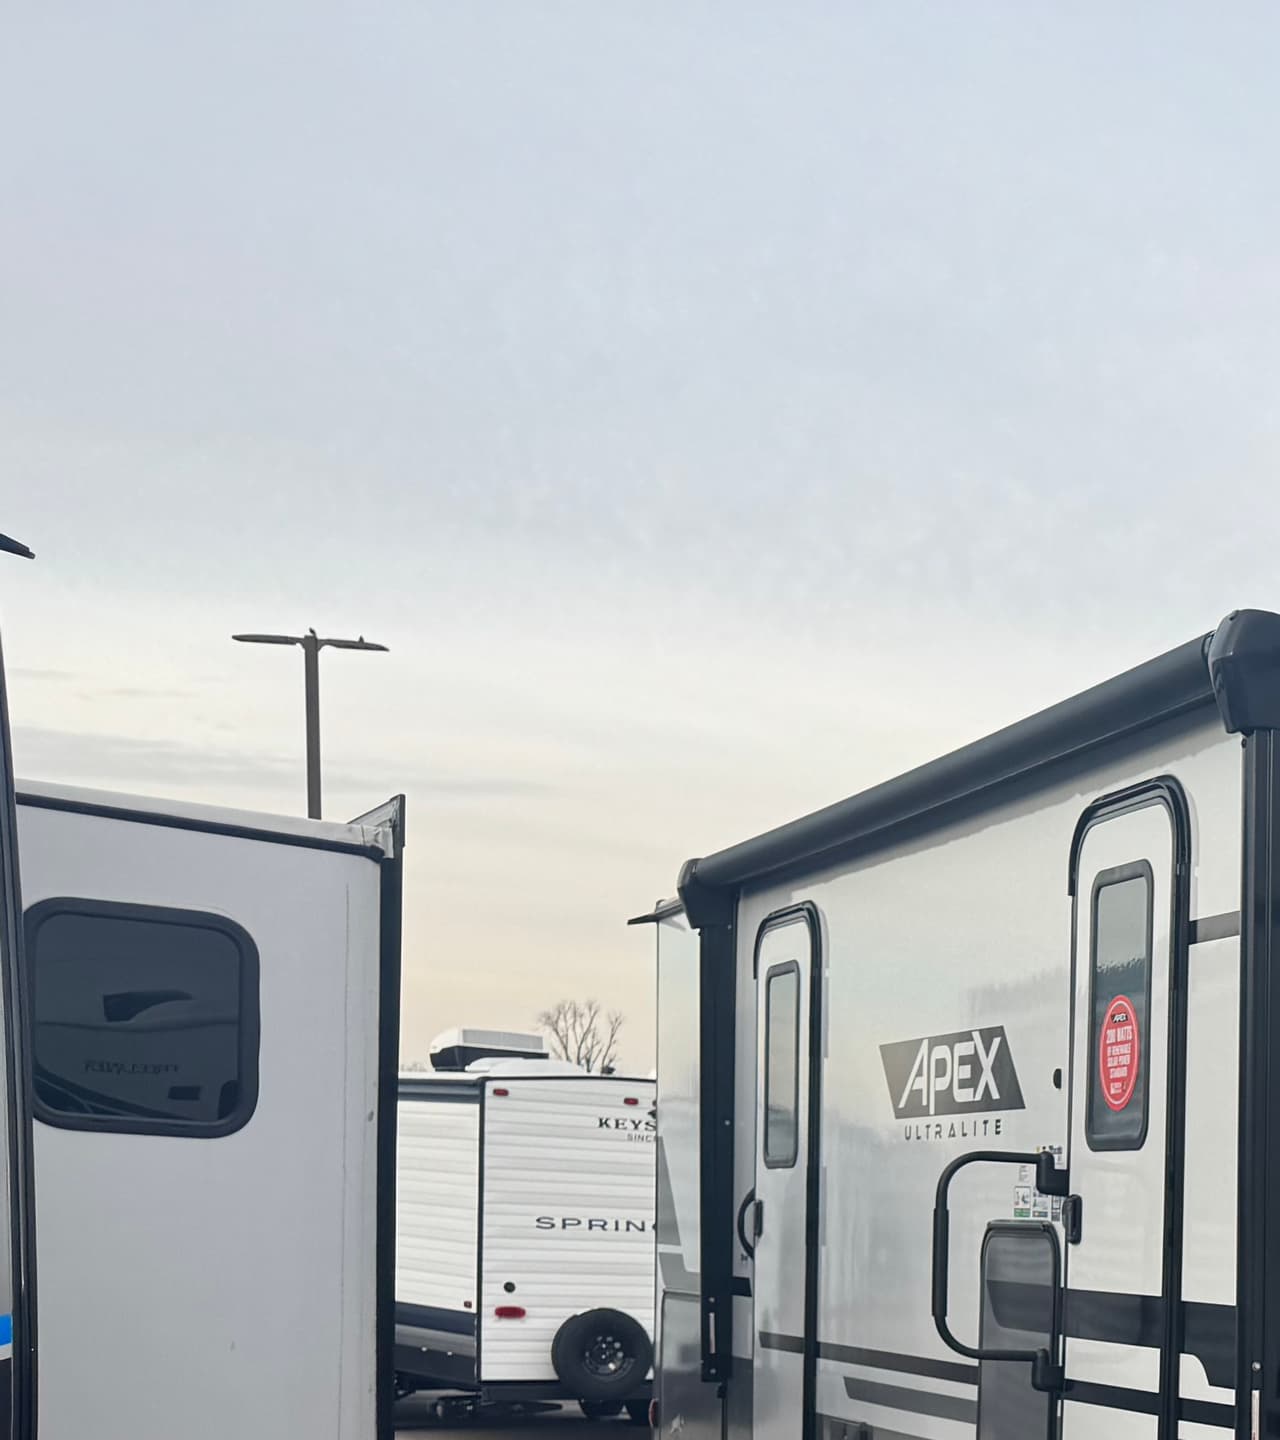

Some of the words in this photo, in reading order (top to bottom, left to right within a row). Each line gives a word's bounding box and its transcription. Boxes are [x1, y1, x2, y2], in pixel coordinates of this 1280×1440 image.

[897, 1030, 1002, 1116] APEX
[904, 1118, 1002, 1141] ULTRALITE
[535, 1216, 657, 1233] SPRIN
